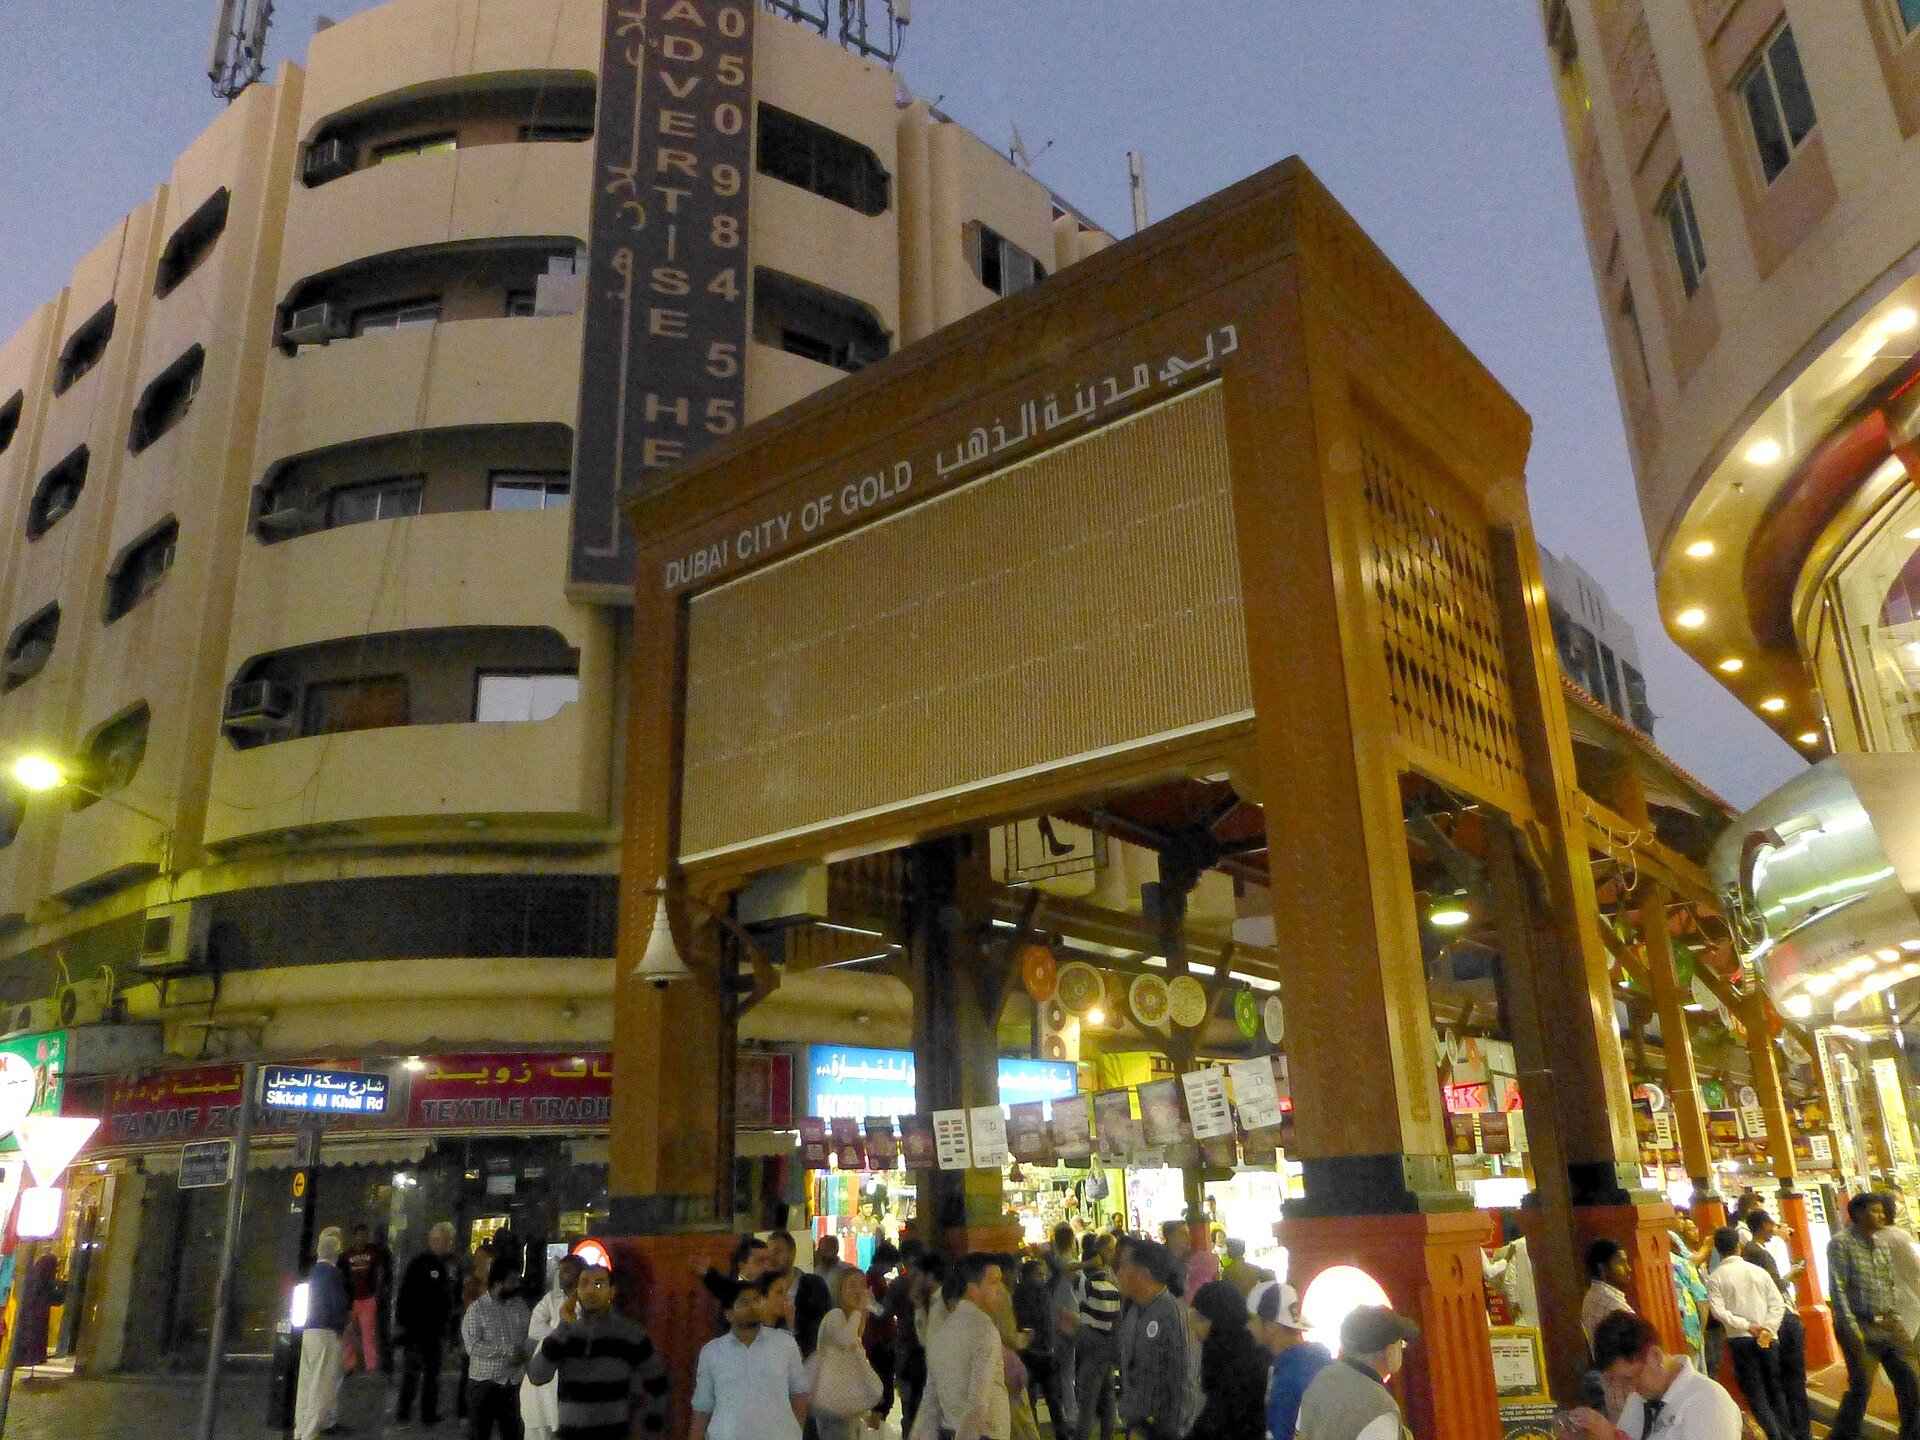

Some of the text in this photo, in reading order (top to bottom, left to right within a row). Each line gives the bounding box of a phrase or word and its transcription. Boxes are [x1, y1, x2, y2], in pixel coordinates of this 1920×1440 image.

[649, 0, 706, 340] ADVERTISE
[935, 323, 1239, 482] دبي مدينة الذهب
[664, 460, 914, 590] DUBAI CITY OF GOLD
[265, 1090, 308, 1107] Sikkat
[312, 1093, 328, 1108] Al
[366, 1096, 384, 1111] Rd
[267, 1071, 385, 1096] شارع سكة الخيل
[421, 1098, 525, 1123] TEXTILE
